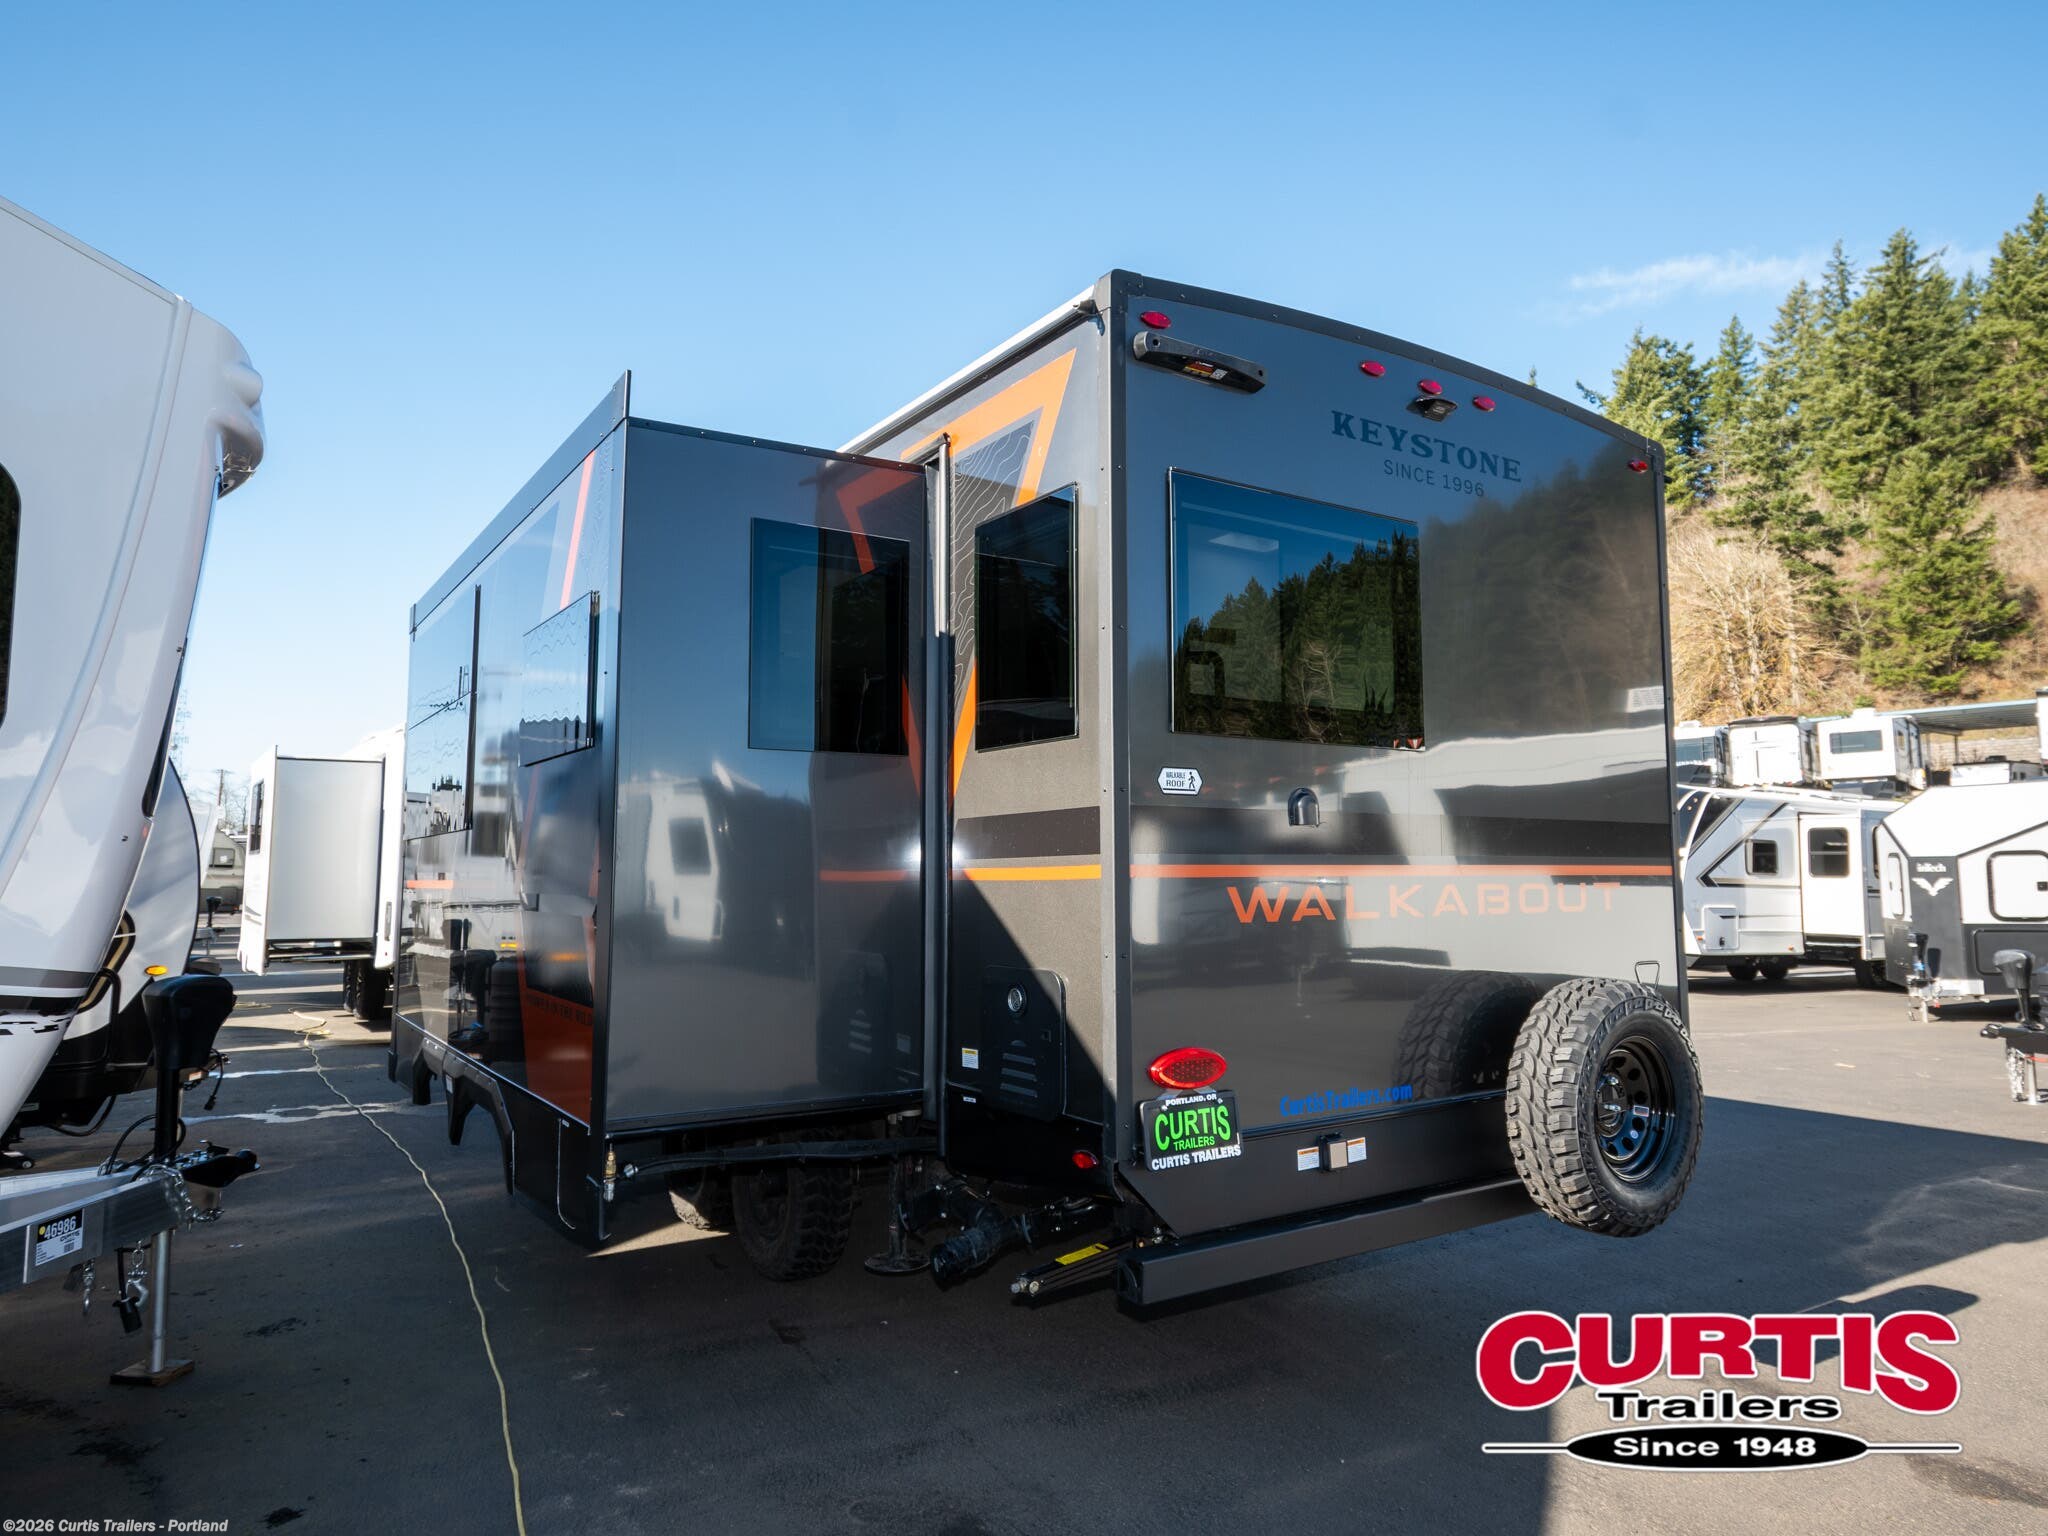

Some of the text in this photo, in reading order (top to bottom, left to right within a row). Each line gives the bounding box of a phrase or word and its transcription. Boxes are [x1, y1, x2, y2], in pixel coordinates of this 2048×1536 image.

[1331, 410, 1521, 482] KEYSTONE
[1384, 460, 1484, 497] SINCE 1996
[1166, 779, 1185, 787] ROOF
[1226, 882, 1621, 923] WALKABOUT
[1280, 1084, 1413, 1117] CurtisTrailers.com
[1155, 1105, 1231, 1150] CURTIS
[1174, 1136, 1215, 1151] TRAILERS
[1152, 1144, 1241, 1170] CURTIS TRAILERS
[44, 1216, 76, 1239] 46986
